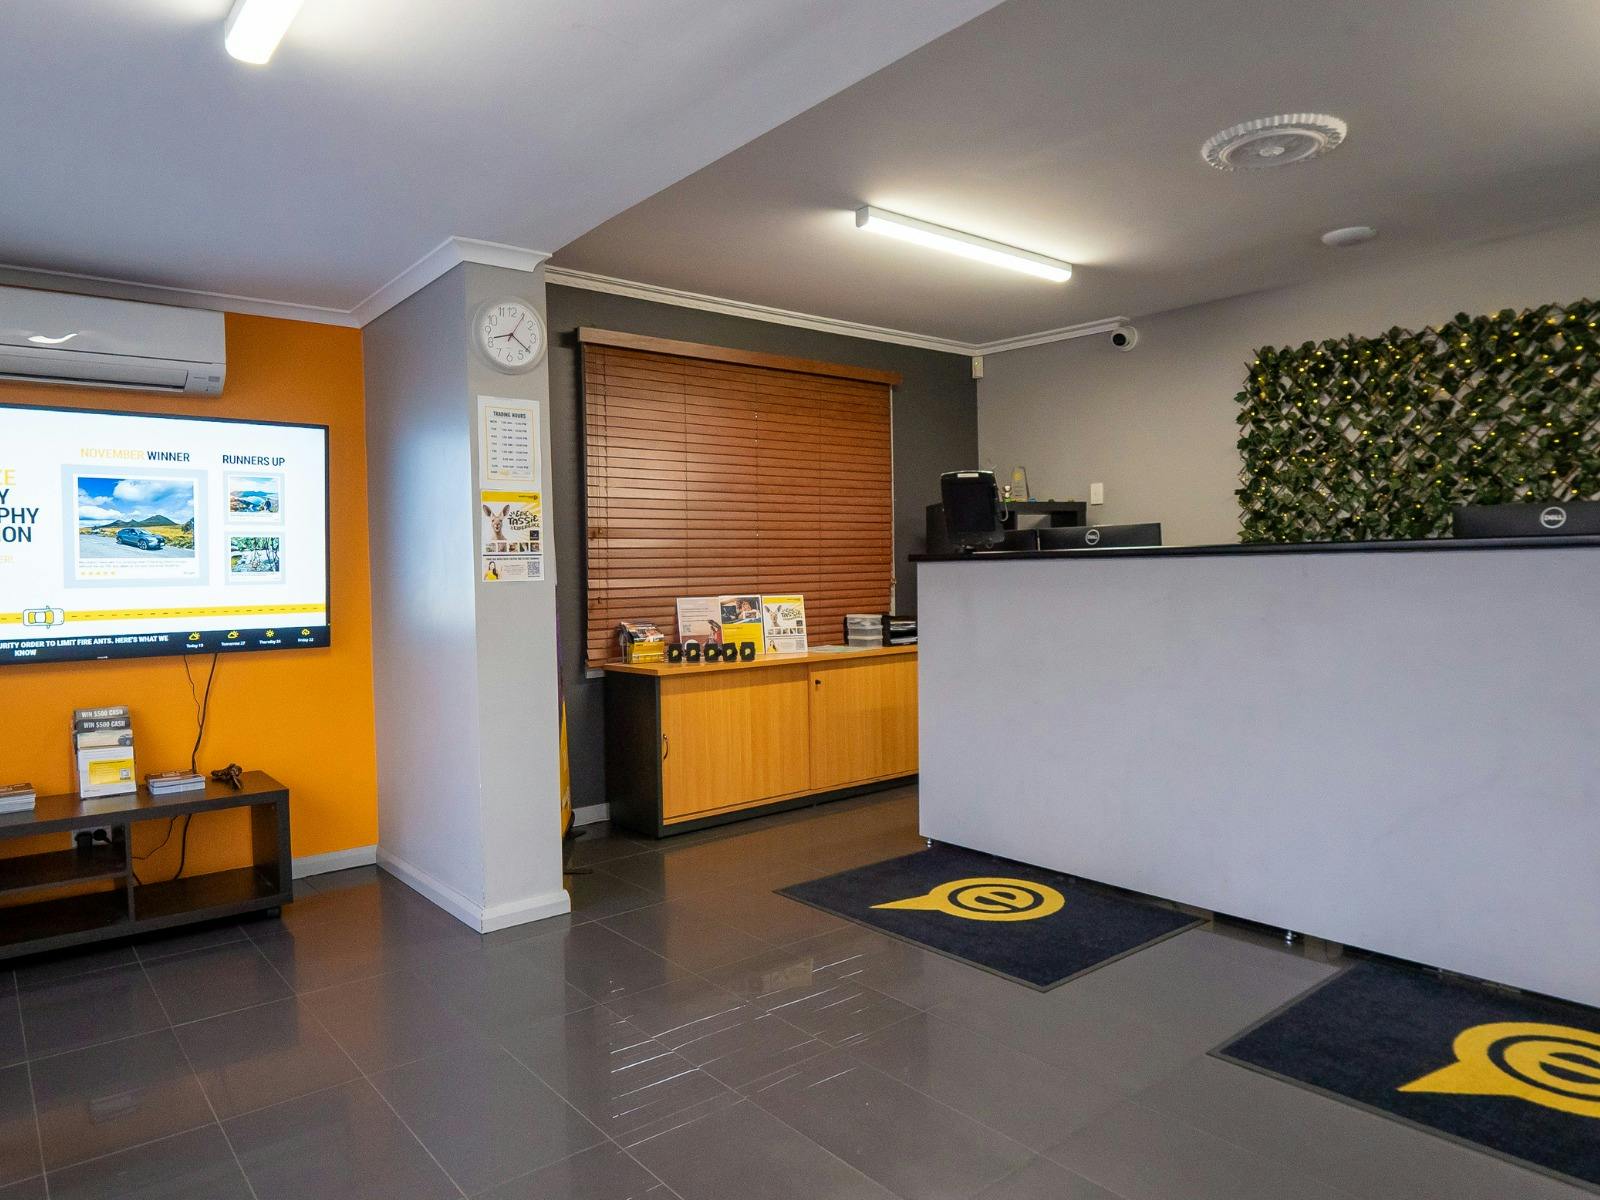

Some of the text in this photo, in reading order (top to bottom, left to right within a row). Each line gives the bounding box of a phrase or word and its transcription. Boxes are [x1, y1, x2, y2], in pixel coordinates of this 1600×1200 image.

[80, 448, 190, 462] NOVEMBER WINNER
[222, 454, 286, 466] RUNNERS UP
[0, 507, 40, 524] PHY
[20, 640, 45, 648] ORDER
[56, 639, 77, 647] LIMIT
[77, 638, 92, 646] FIRE
[92, 637, 114, 645] ANTS.
[158, 634, 169, 642] WE
[14, 649, 37, 657] KNOW
